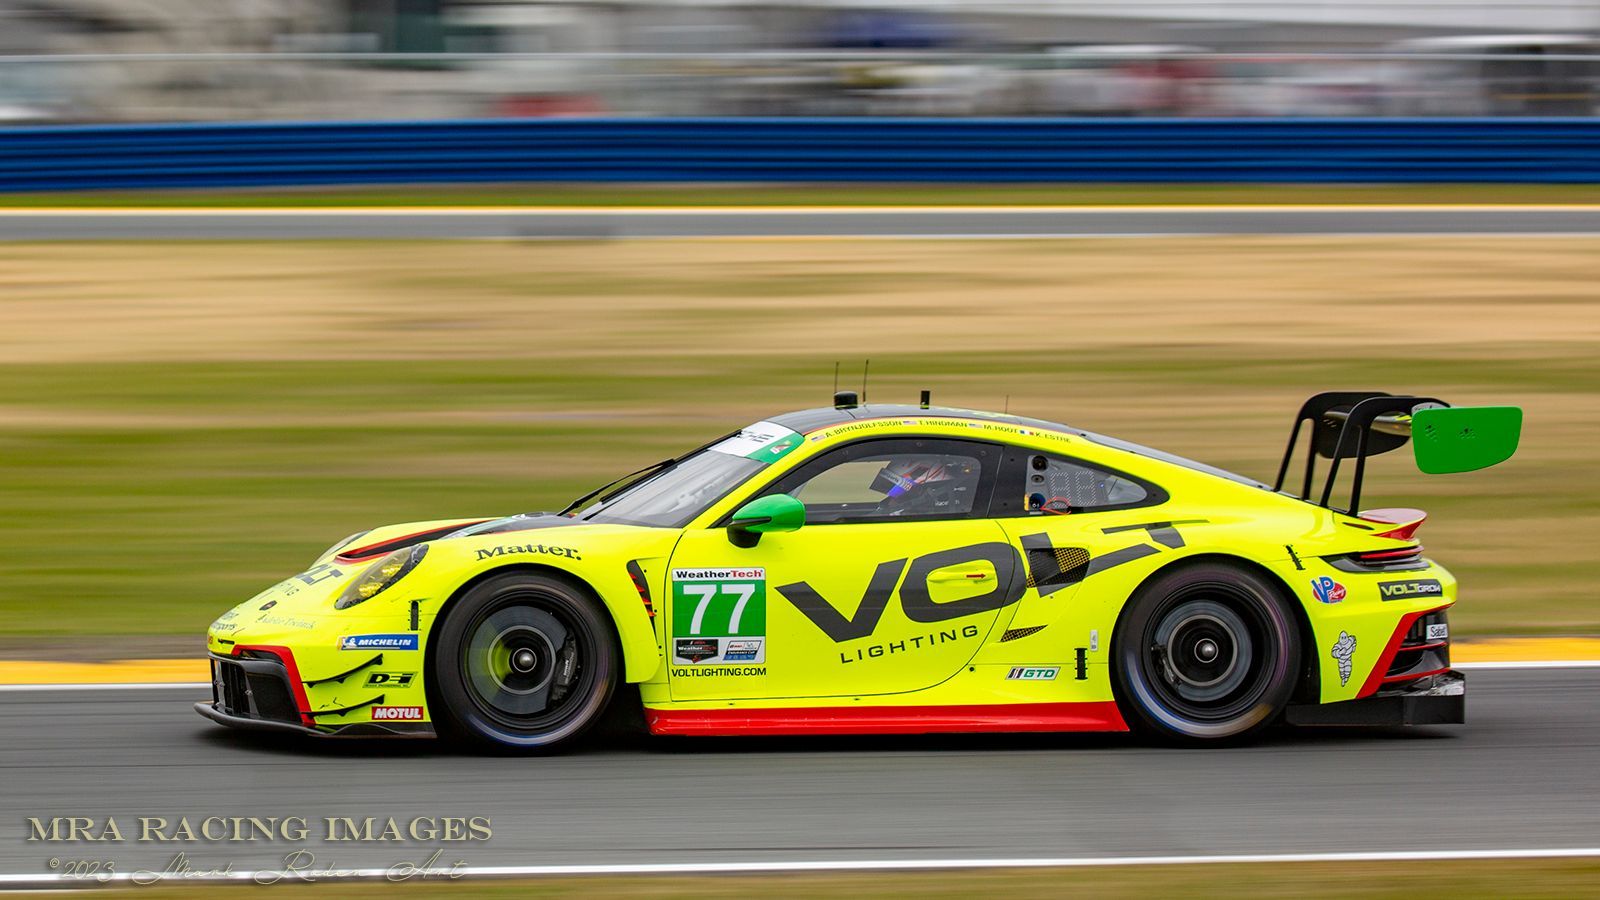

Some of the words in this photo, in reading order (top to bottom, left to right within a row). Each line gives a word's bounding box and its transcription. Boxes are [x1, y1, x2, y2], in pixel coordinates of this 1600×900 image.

[475, 544, 582, 561] Matter.
[676, 569, 762, 579] WeatherTech
[774, 518, 1210, 643] VOLT
[1311, 576, 1335, 603] VP
[683, 583, 755, 634] 77
[358, 638, 411, 646] MICHELIN
[840, 624, 979, 665] LIGHTING
[671, 667, 767, 677] VOLTLIGHTING.COM
[1024, 669, 1055, 678] GTD
[374, 707, 421, 719] MOTUL
